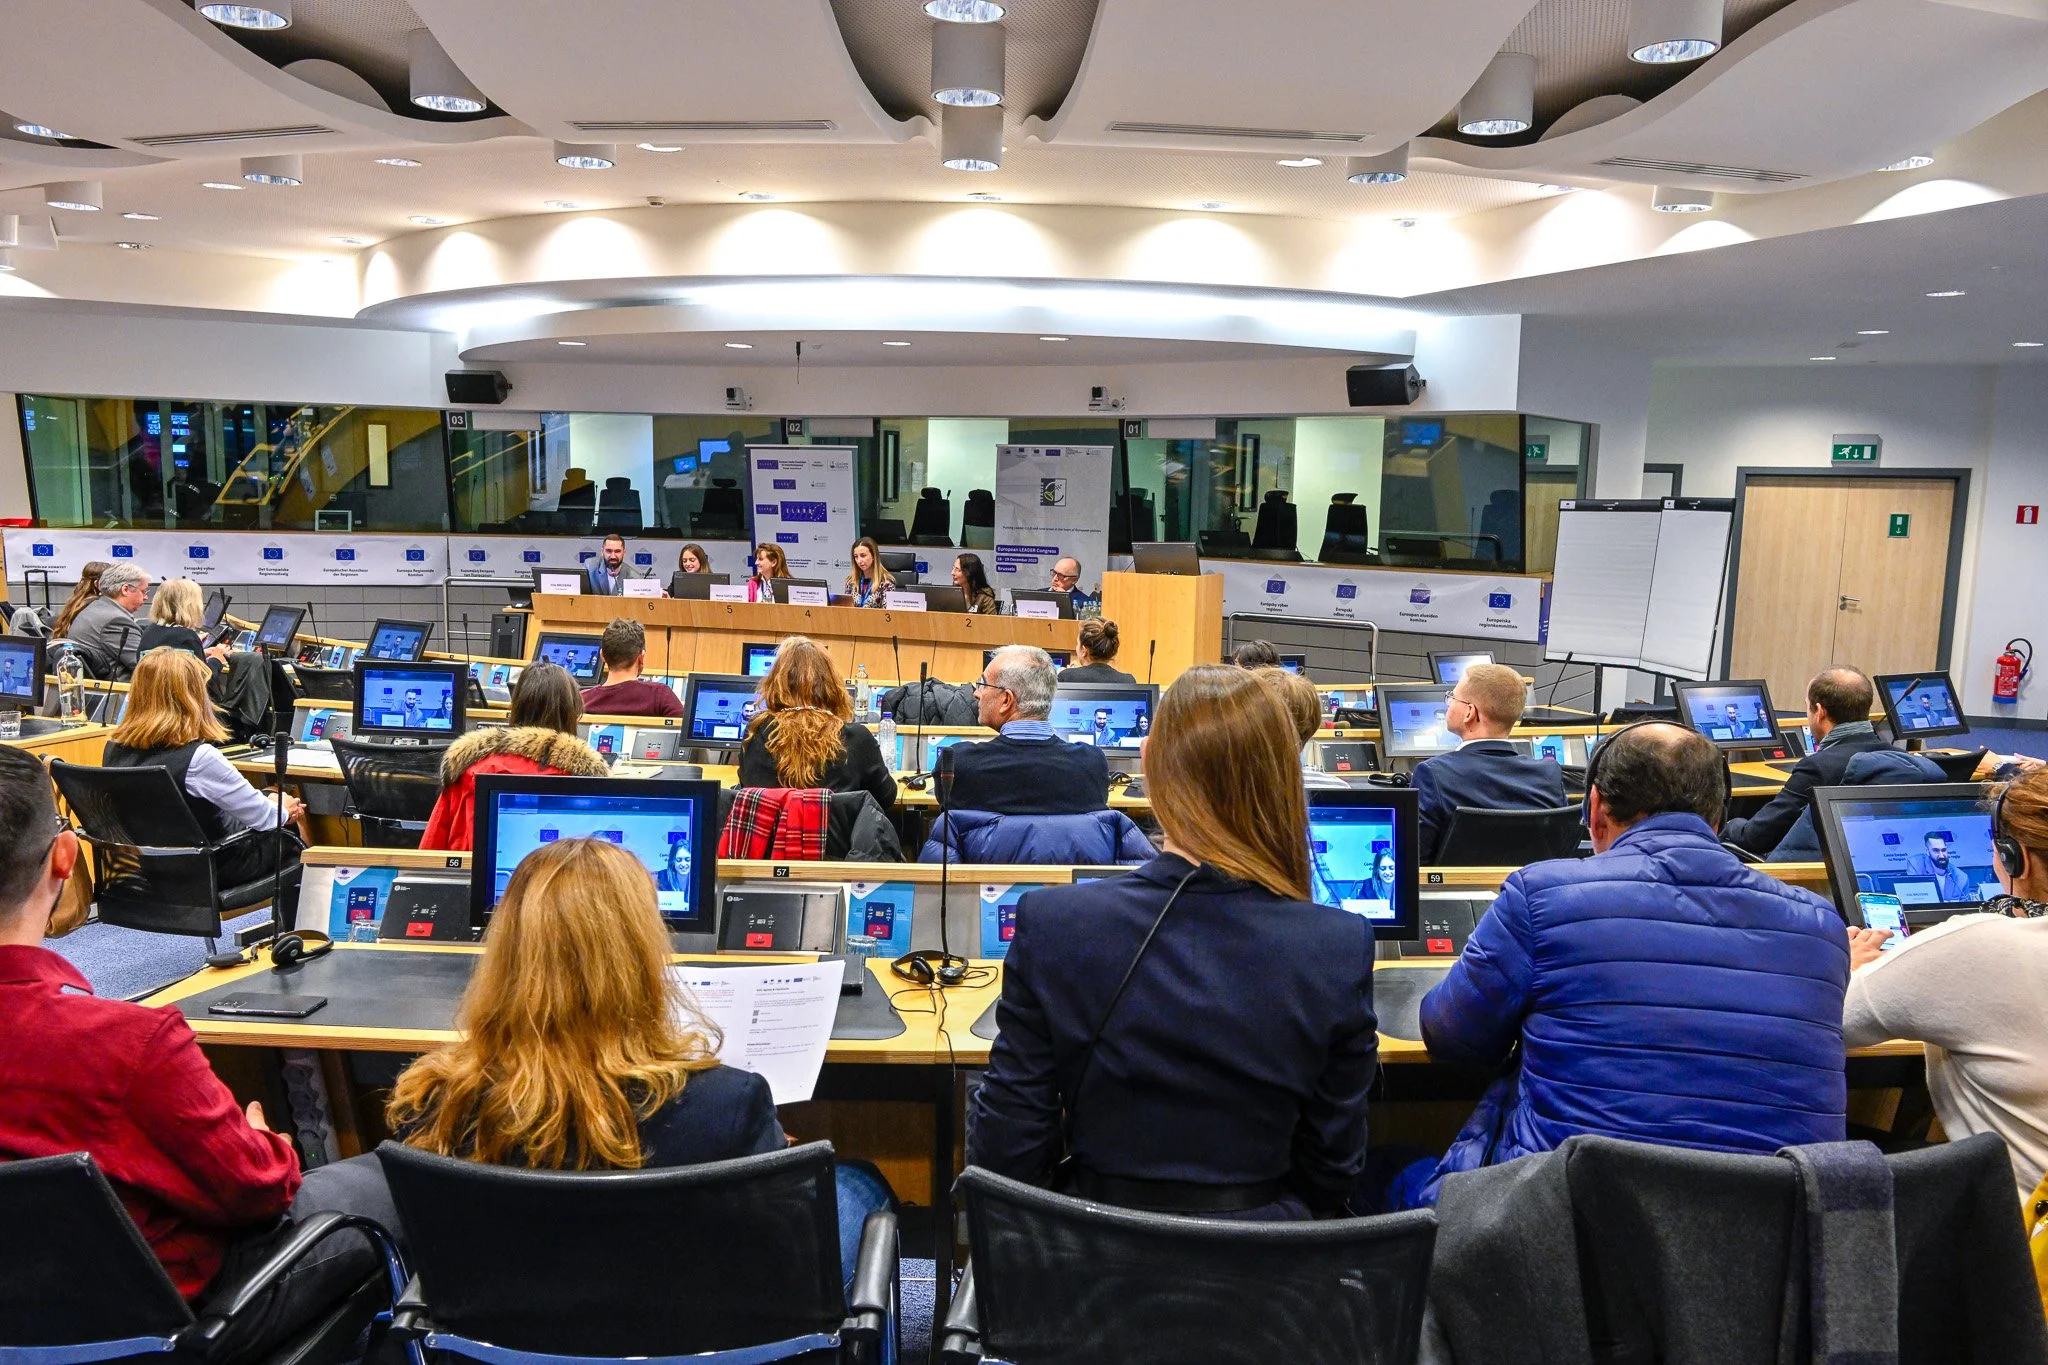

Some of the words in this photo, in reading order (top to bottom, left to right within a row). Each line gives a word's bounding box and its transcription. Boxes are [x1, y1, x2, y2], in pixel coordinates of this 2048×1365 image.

[451, 415, 464, 425] 03
[790, 423, 800, 432] 02
[1128, 424, 1139, 434] 01
[569, 598, 574, 606] 7
[648, 602, 654, 610] 6
[727, 605, 733, 613] 5
[805, 610, 811, 618] 4
[885, 613, 891, 622] 3
[966, 618, 972, 628] 2
[1048, 623, 1052, 632] 1
[776, 868, 786, 877] 57
